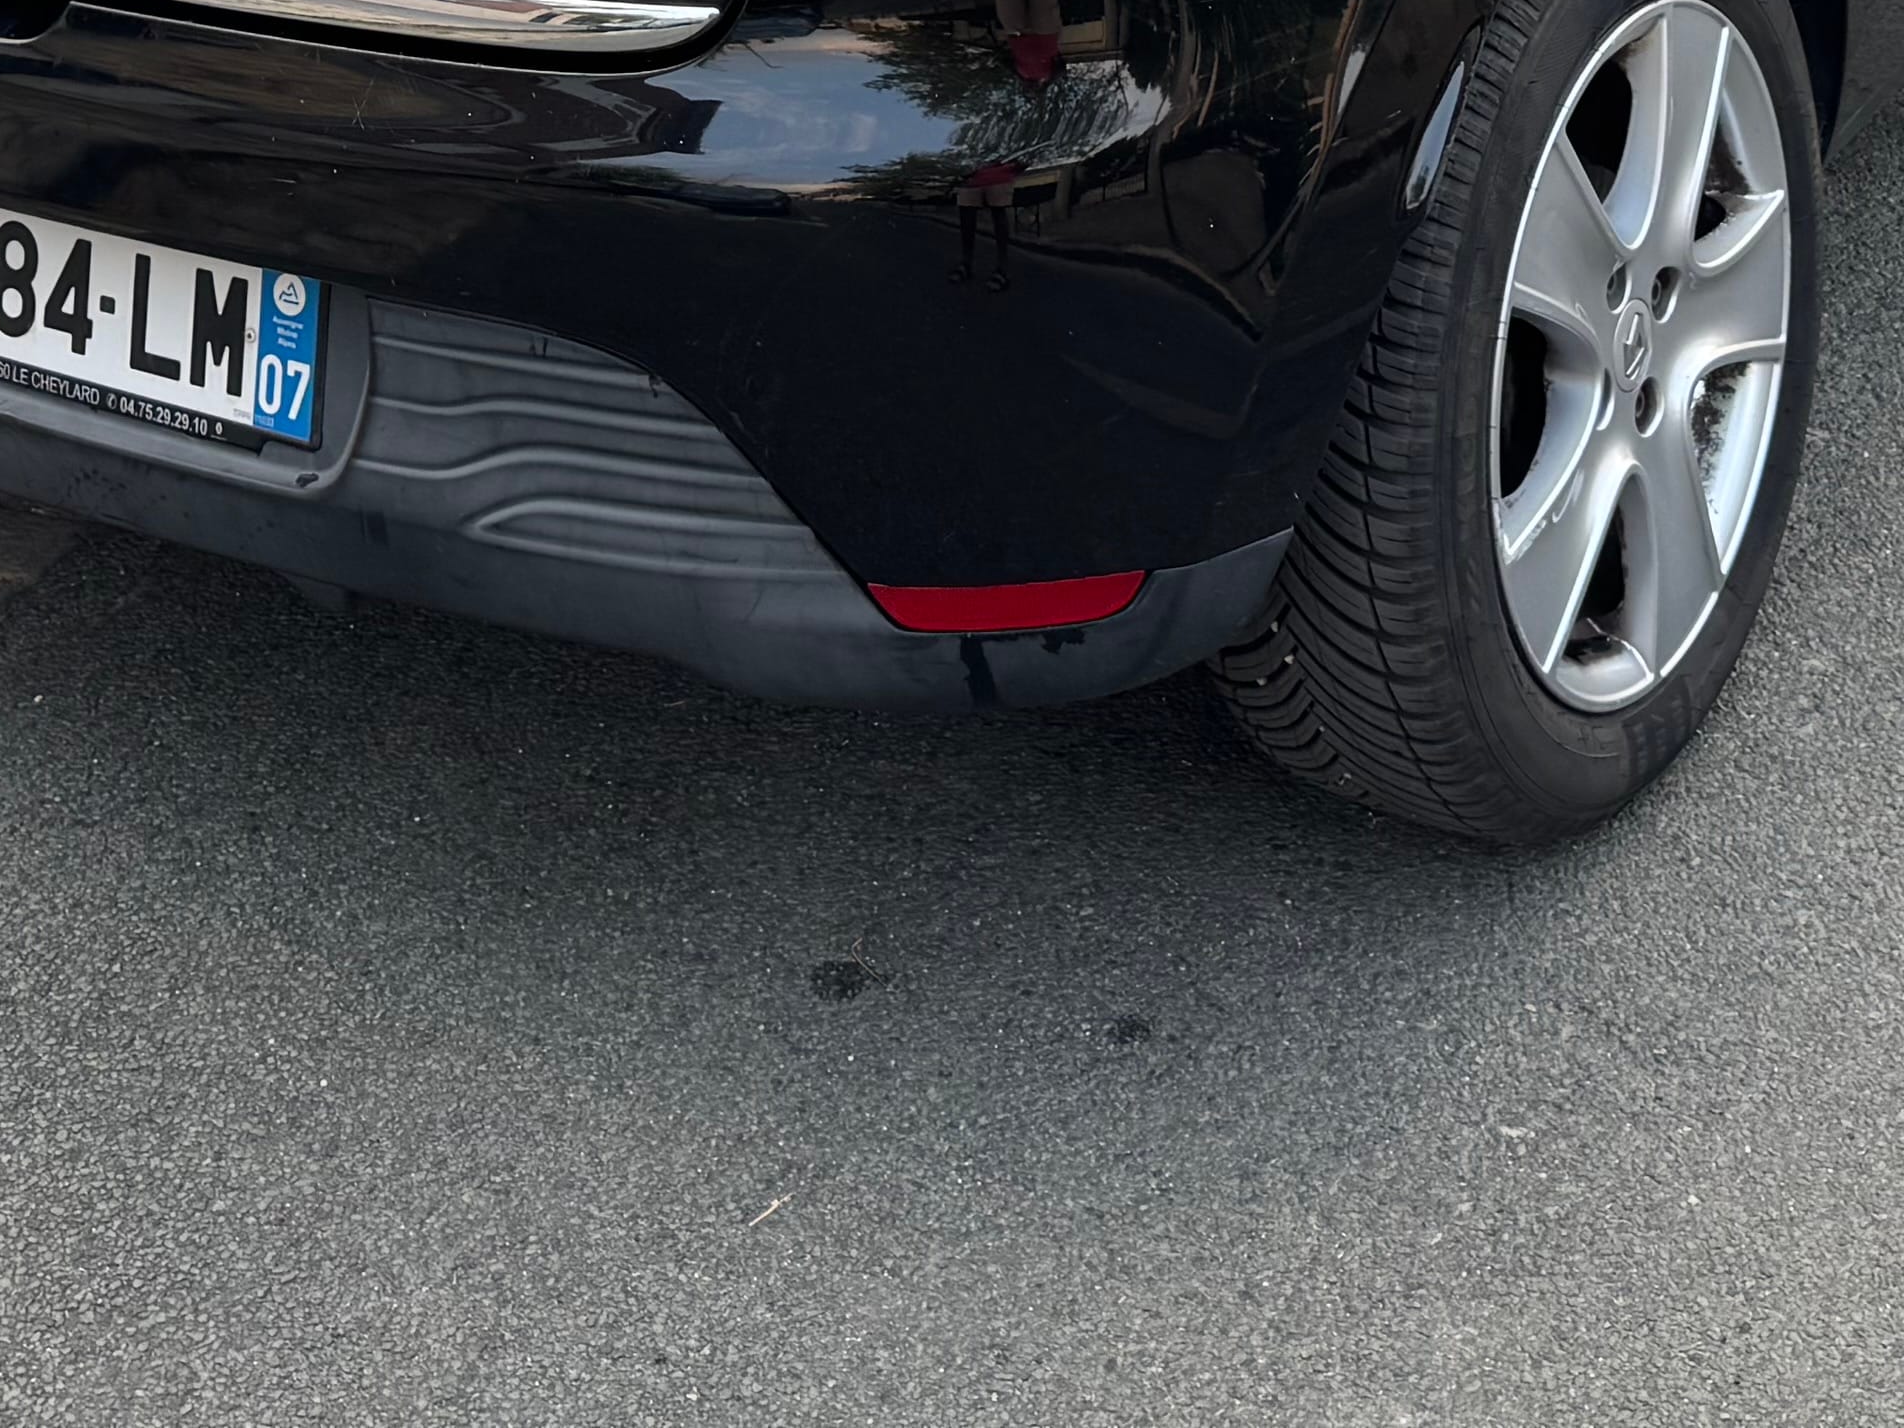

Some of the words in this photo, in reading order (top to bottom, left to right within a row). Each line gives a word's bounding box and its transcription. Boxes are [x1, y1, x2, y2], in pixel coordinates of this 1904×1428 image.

[12, 366, 29, 386] LE
[31, 372, 100, 406] CHEYLARD
[119, 395, 208, 436] 04.75.29.29.10
[258, 353, 311, 421] 07
